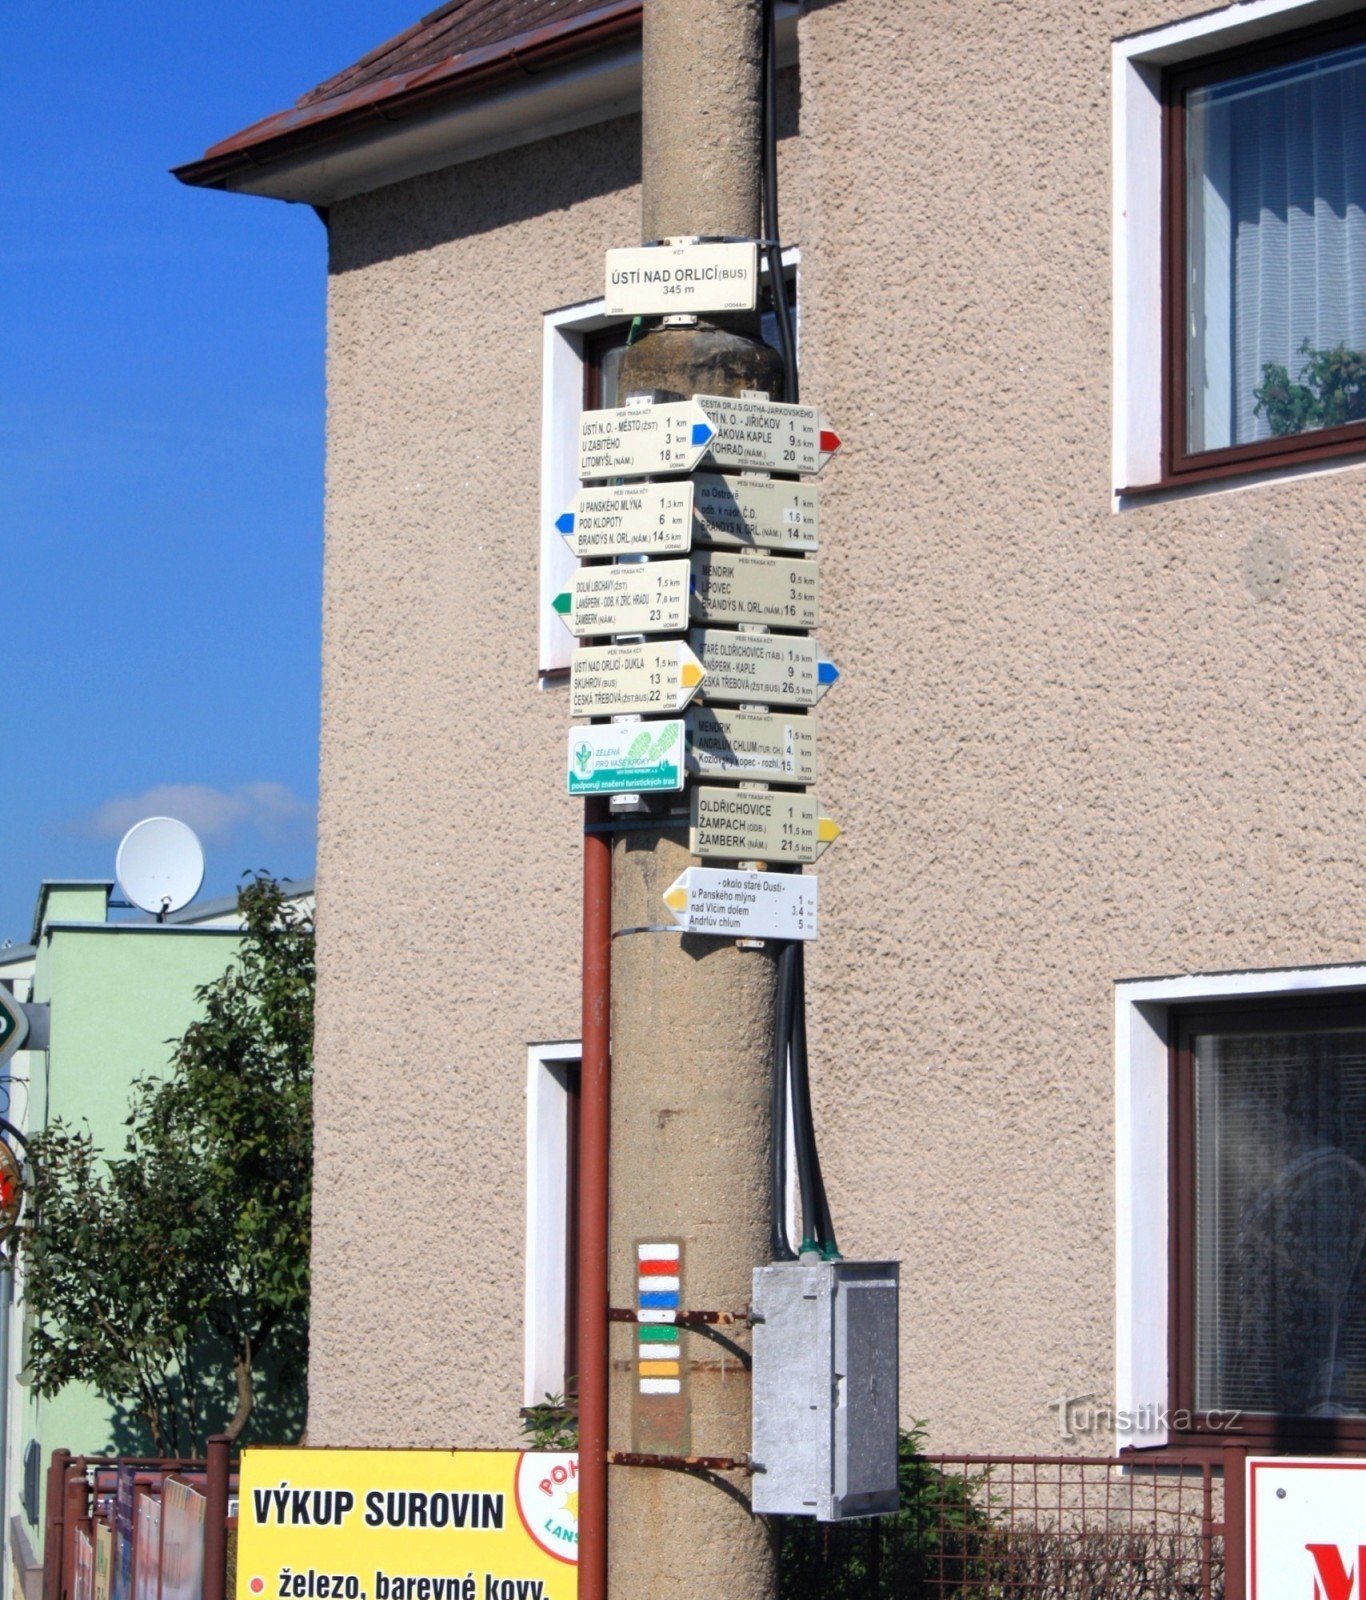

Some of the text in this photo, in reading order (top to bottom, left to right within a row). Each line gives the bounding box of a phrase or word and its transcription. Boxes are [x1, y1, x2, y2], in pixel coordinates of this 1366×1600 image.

[612, 269, 640, 284] ÚSTÍ
[644, 270, 670, 282] NAD
[663, 285, 681, 294] 345
[701, 400, 721, 409] CESTA
[583, 422, 597, 435] ÚSTÍ
[599, 424, 605, 434] N.
[607, 423, 612, 433] O.
[667, 418, 670, 427] 1
[707, 411, 718, 420] STÍ
[720, 413, 727, 423] N.
[730, 414, 738, 425] O.
[789, 421, 794, 431] 1
[582, 442, 586, 451] U
[588, 438, 619, 451] ZABITÉHO
[666, 434, 671, 444] 3
[747, 432, 772, 443] KAPLE
[712, 443, 743, 455] TOHRAD
[784, 450, 795, 460] 20
[582, 453, 612, 468] LITOMYŠL
[661, 450, 670, 460] 18
[580, 503, 584, 513] U
[586, 499, 619, 512] PANSKÉHO
[621, 497, 642, 511] MLÝNA
[661, 498, 671, 508] 1,3
[794, 497, 798, 506] 1
[803, 500, 813, 508] km
[580, 519, 592, 529] POD
[594, 517, 623, 528] KLOPOTY
[659, 515, 665, 524] 6
[579, 533, 607, 545] BRANDÝS
[609, 535, 615, 544] N.
[653, 531, 669, 541] 14,5
[788, 528, 799, 538] 14
[702, 566, 734, 578] MENDRIK
[657, 577, 668, 588] 1,5
[702, 583, 731, 594] LIPOVEC
[702, 598, 736, 611] BRANDÝS
[739, 601, 745, 611] N.
[785, 605, 795, 616] 16
[650, 610, 660, 620] 23
[721, 643, 764, 659] OLDŘICHOVICE
[574, 659, 587, 673] ÚSTÍ
[588, 661, 599, 671] NAD
[602, 657, 620, 671] ORLICÍ
[625, 658, 644, 669] DUKLA
[656, 657, 665, 667] 1,5
[704, 658, 731, 673] ANŠPERK
[737, 663, 755, 674] KAPLE
[788, 667, 794, 677] 9
[574, 679, 601, 689] SKUHROV
[650, 674, 660, 684] 13
[783, 682, 800, 693] 26,5
[574, 692, 593, 706] ČESKÁ
[650, 691, 660, 701] 22
[699, 721, 731, 733] MENDRIK
[596, 748, 620, 756] ZELENÁ
[700, 800, 771, 816] OLDŘICHOVICE
[788, 808, 792, 818] 1
[699, 815, 746, 830] ŽAMPACH
[783, 824, 799, 835] 11,5
[801, 828, 812, 836] km
[699, 832, 745, 847] ŽAMBERK
[781, 840, 799, 852] 21,5
[723, 878, 741, 888] okolo
[735, 892, 755, 904] mlýna
[799, 896, 802, 904] 1
[728, 907, 749, 915] dolem
[719, 918, 740, 927] chlum
[799, 920, 803, 929] 5
[254, 1483, 503, 1528] VÝKUP SUROVIN
[279, 1569, 549, 1600] železo, barevné kovy
